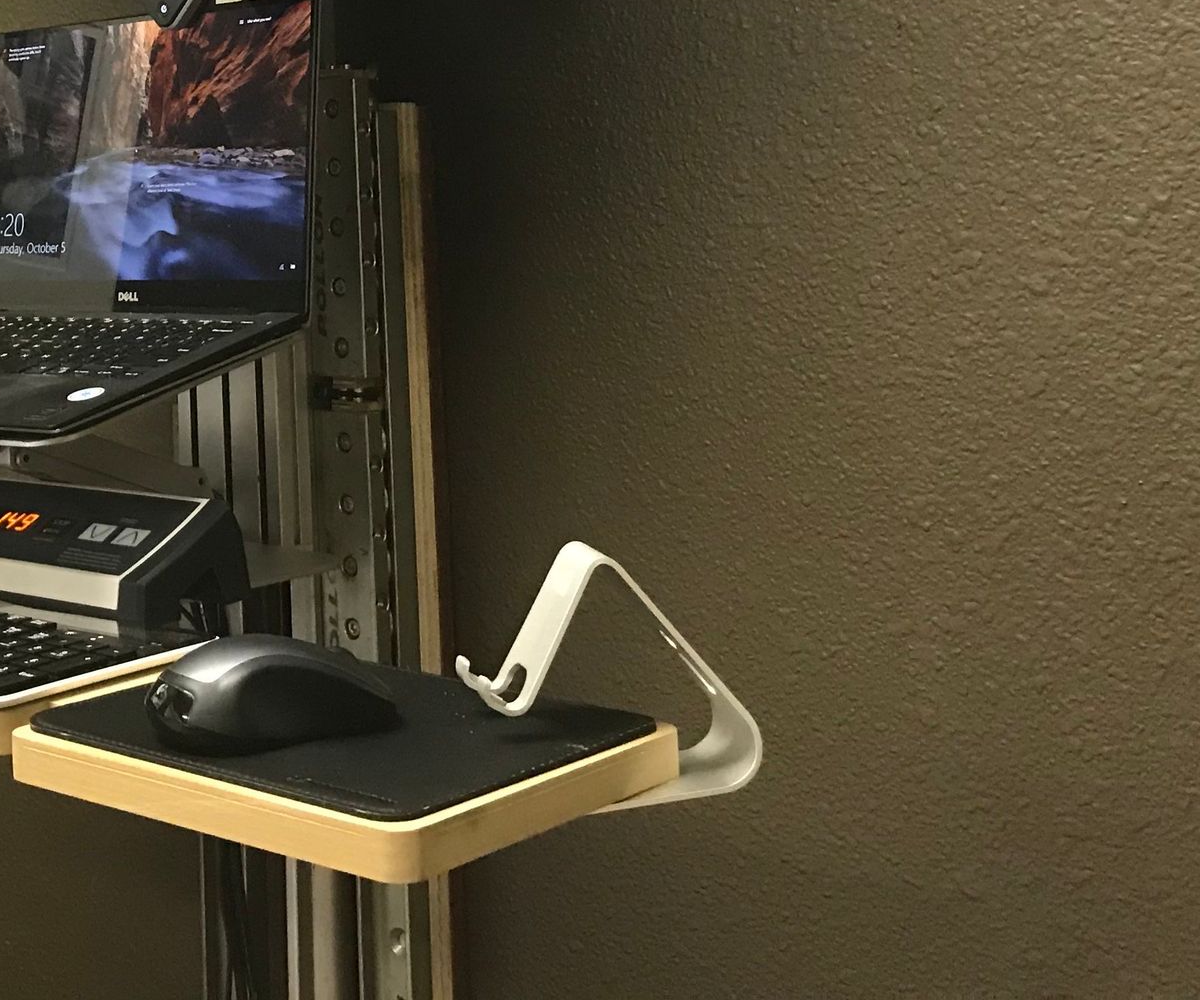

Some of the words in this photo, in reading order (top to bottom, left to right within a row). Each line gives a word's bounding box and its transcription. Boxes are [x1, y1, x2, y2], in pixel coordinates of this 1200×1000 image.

[26, 242, 59, 254] October
[60, 241, 66, 253] 5
[117, 291, 139, 302] DELL
